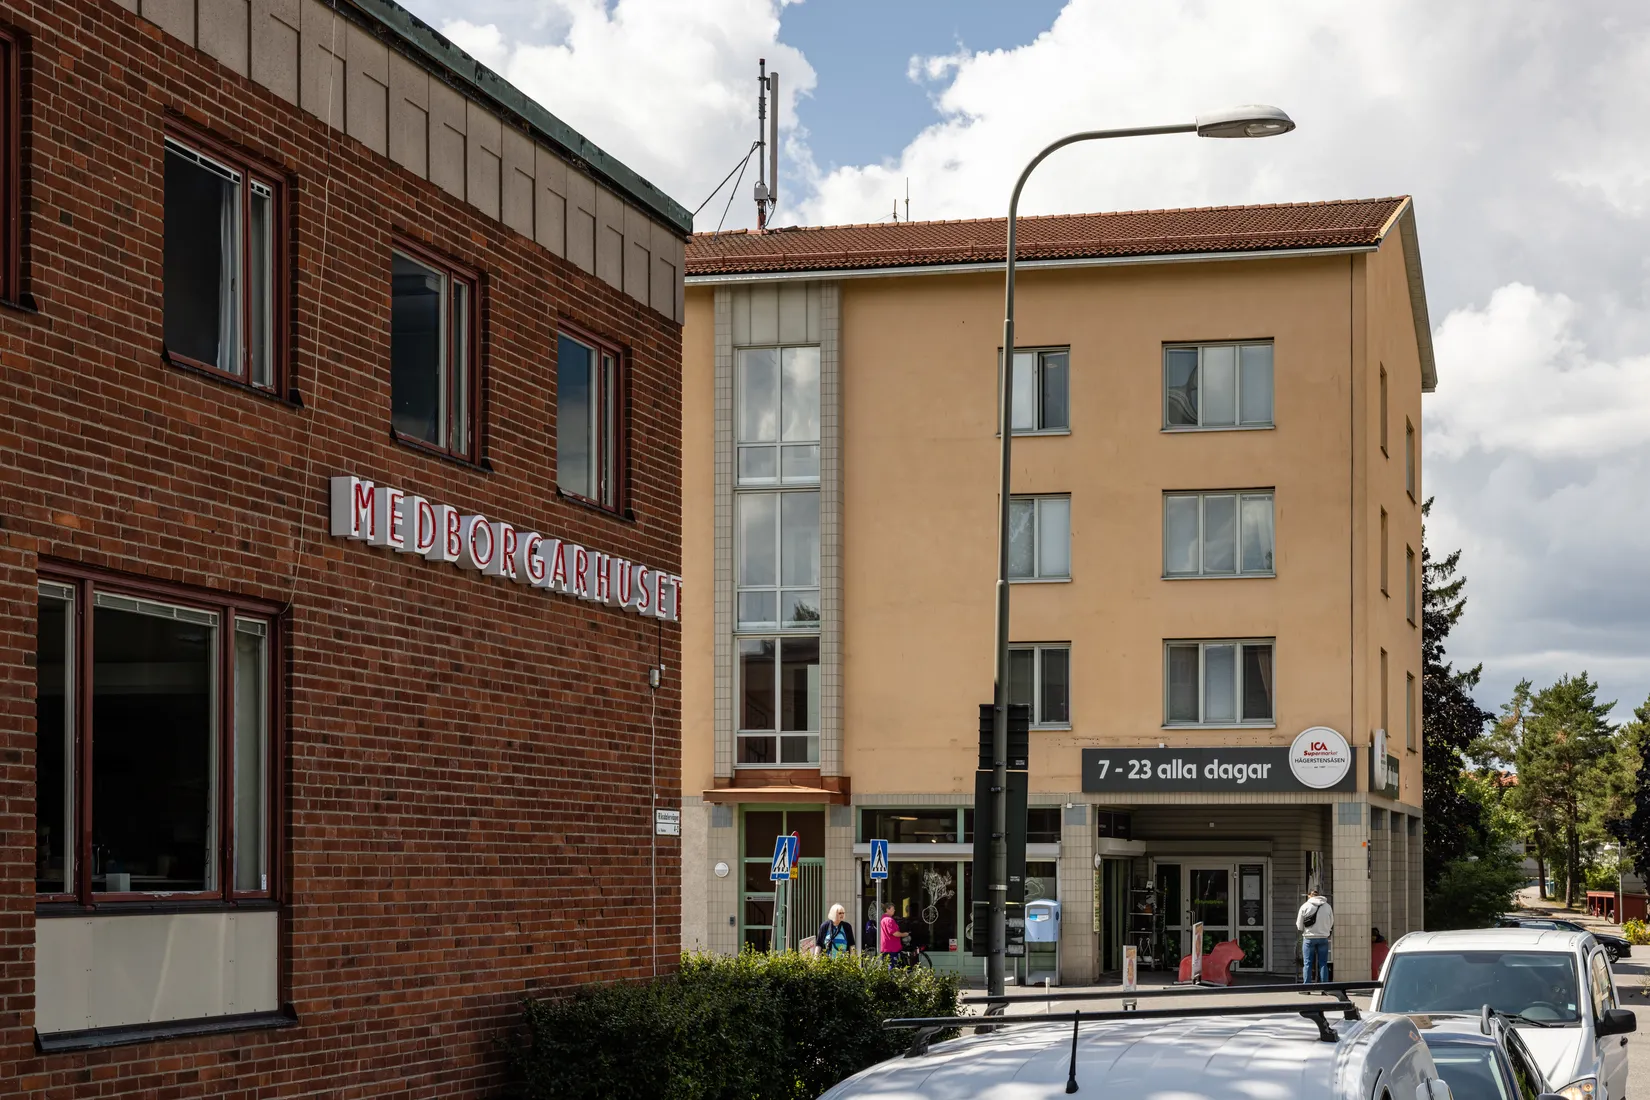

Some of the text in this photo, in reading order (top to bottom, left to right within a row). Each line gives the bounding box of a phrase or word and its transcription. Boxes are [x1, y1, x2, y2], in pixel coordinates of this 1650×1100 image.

[331, 476, 682, 621] MEDBORGARHUSET
[1310, 741, 1328, 751] ICA
[1097, 759, 1111, 780] 7
[1127, 759, 1152, 780] 23
[1157, 758, 1197, 779] alla
[1204, 758, 1272, 784] dagar
